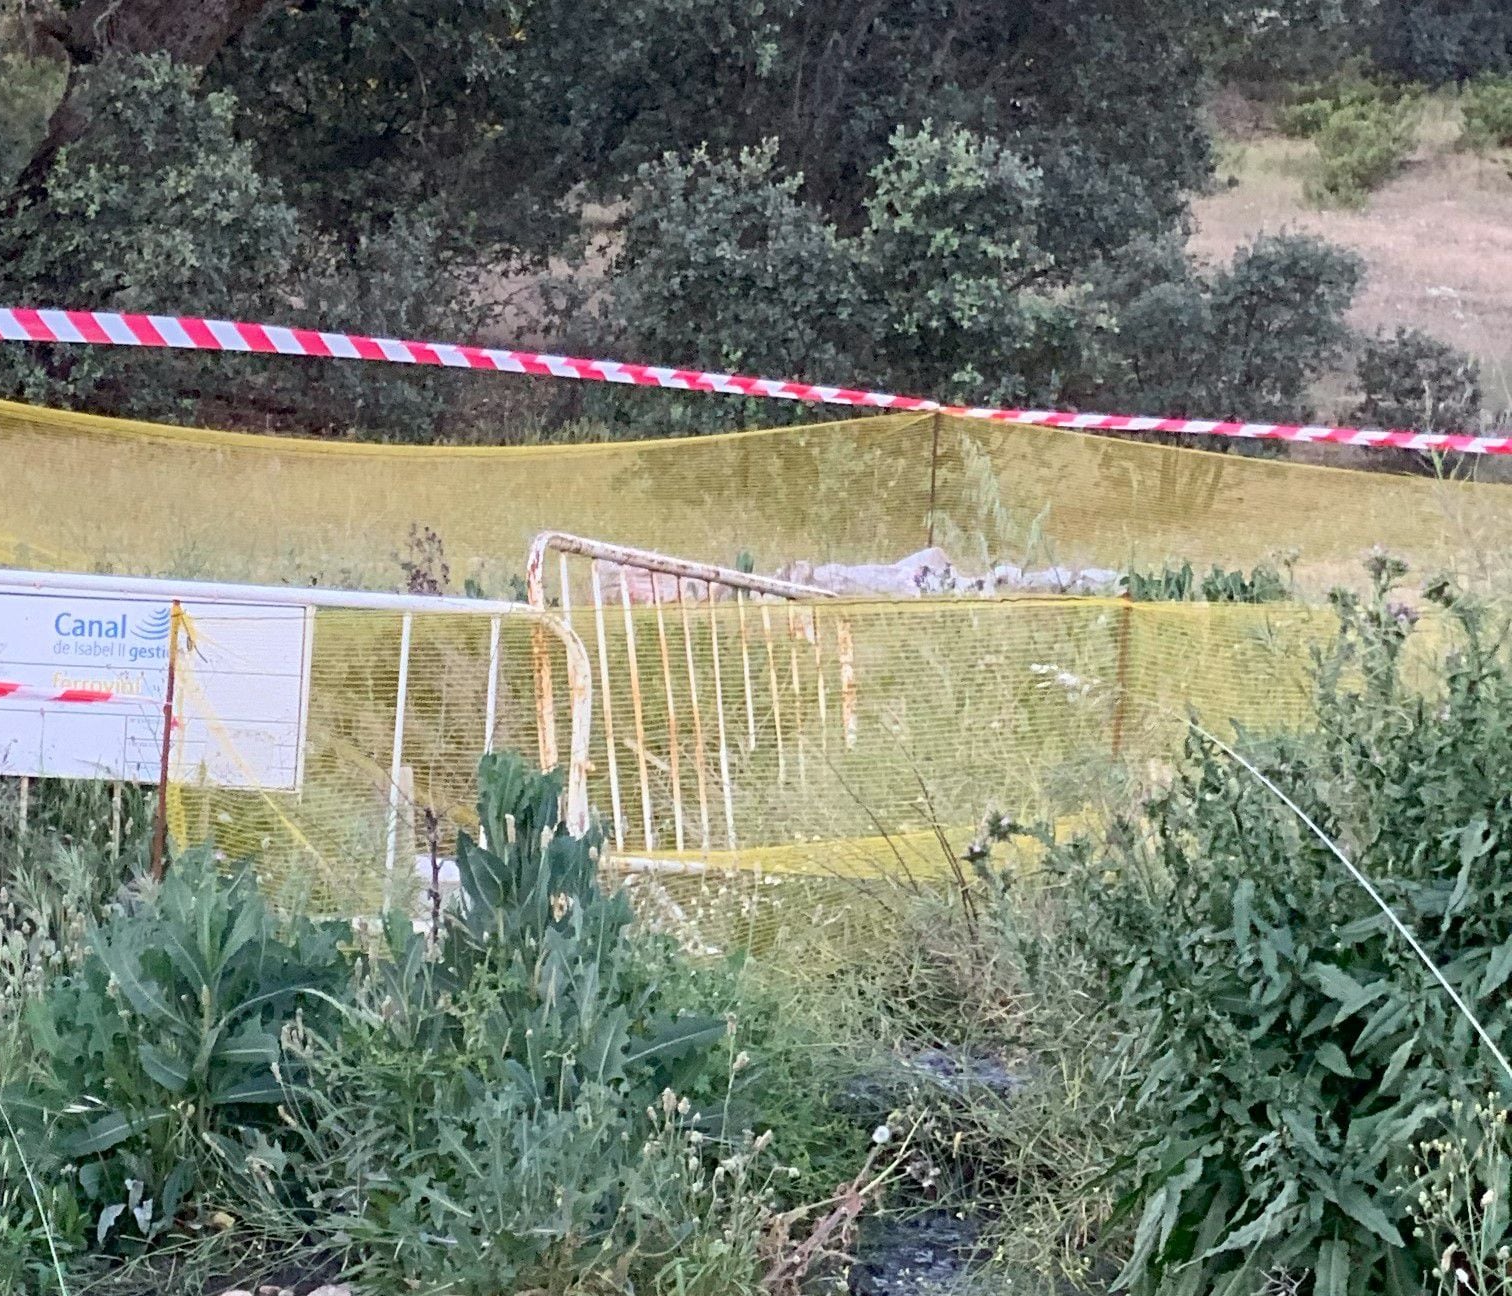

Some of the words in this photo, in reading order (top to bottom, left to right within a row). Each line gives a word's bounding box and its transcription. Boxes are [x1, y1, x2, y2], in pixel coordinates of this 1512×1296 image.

[54, 612, 127, 639] Canal
[53, 640, 71, 655] de
[74, 641, 114, 657] Isabel
